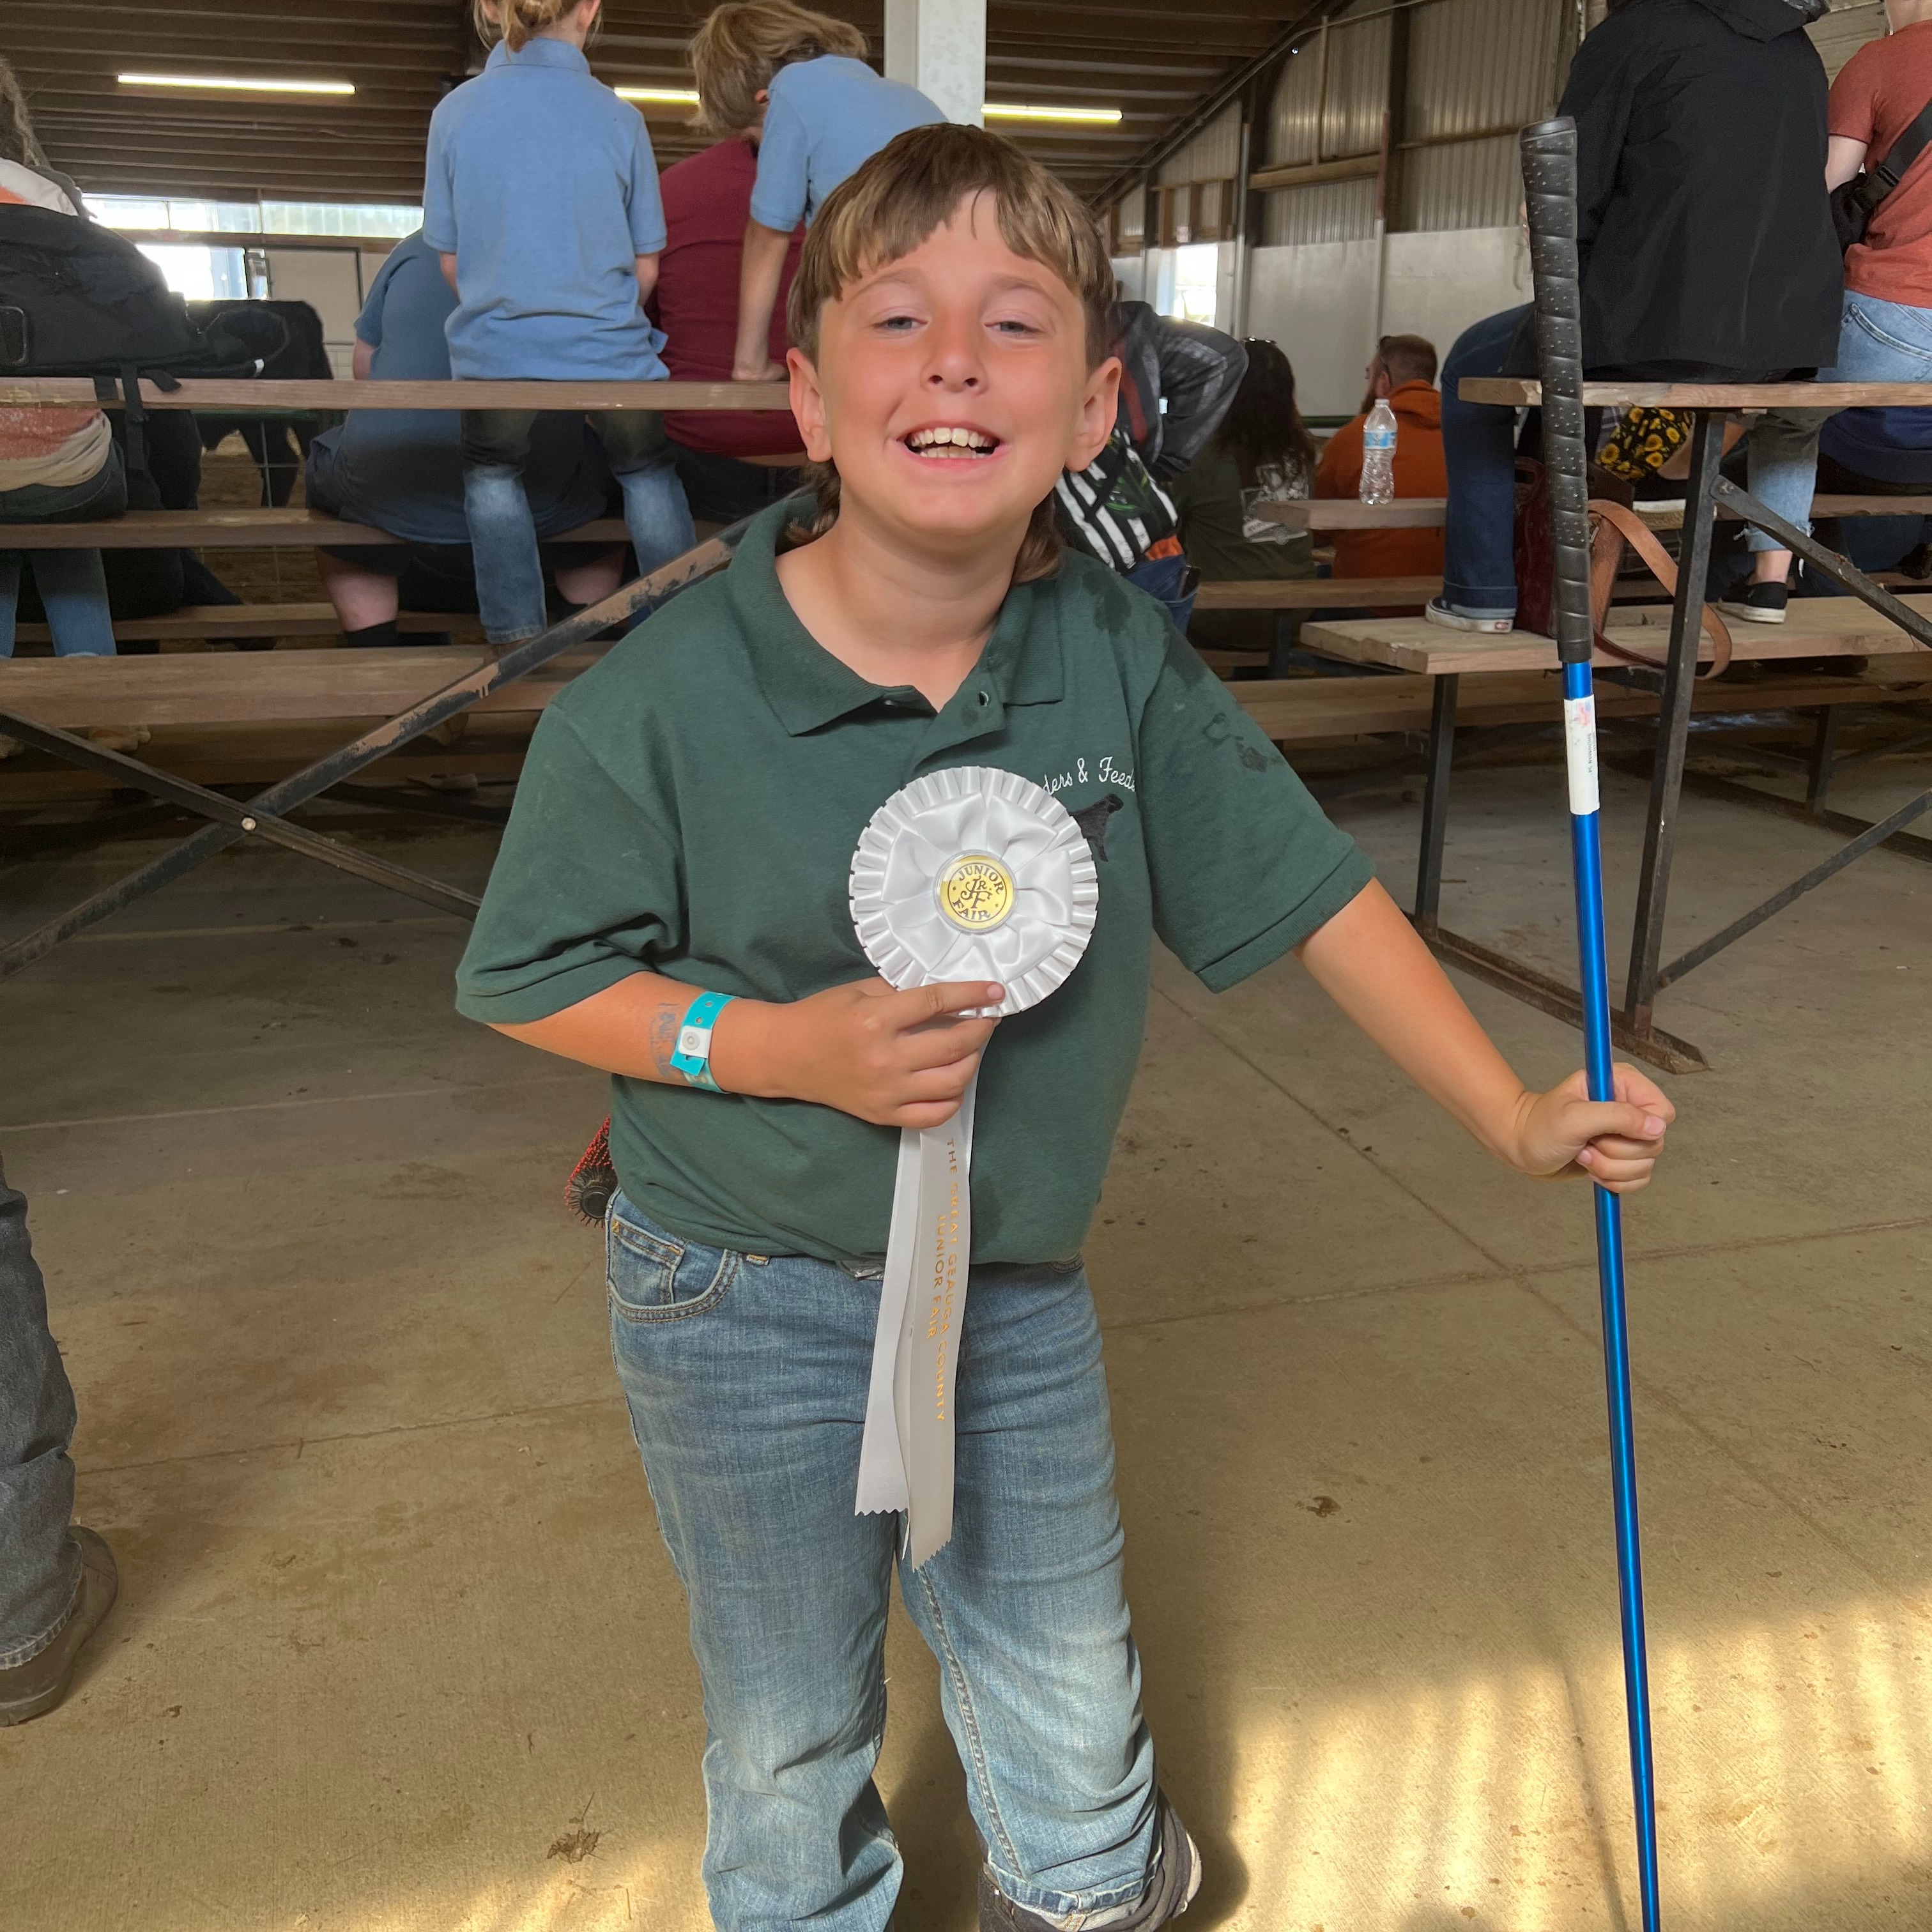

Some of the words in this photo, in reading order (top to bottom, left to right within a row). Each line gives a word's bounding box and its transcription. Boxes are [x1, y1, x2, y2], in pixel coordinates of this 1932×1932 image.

[1077, 757, 1089, 784] &
[958, 865, 1004, 895] JUNIOR
[952, 898, 991, 921] FAIR
[947, 1138, 957, 1174] THE
[949, 1182, 958, 1245] GREAT
[933, 1215, 946, 1289] JUNIOR
[939, 1251, 958, 1335] GEAUGA
[927, 1296, 942, 1340] FAIR
[935, 1339, 947, 1421] COUNTY
